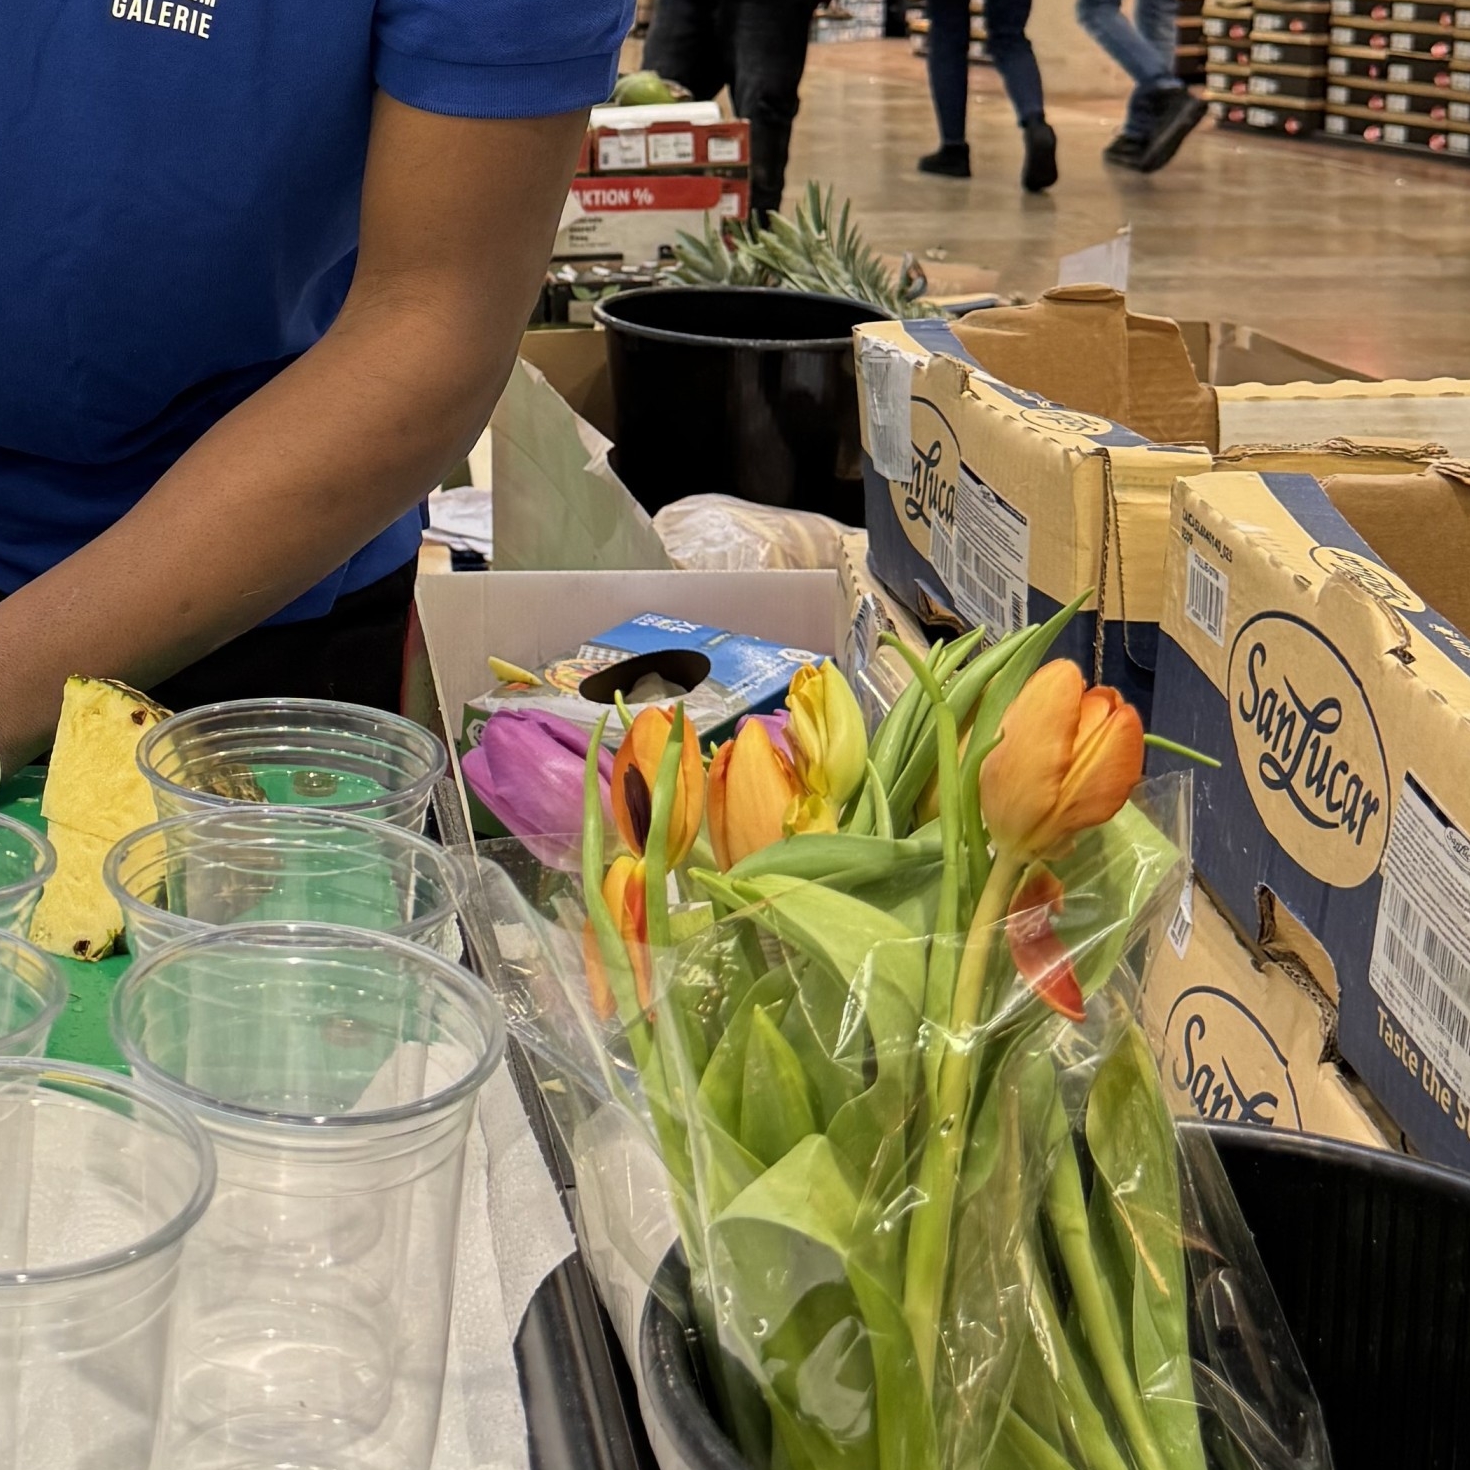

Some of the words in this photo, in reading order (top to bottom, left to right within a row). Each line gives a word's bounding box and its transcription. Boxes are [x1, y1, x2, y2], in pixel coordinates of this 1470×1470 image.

[1239, 642, 1379, 846] SanLucar
[1377, 1005, 1419, 1078] Taste
[1422, 1058, 1452, 1115] the
